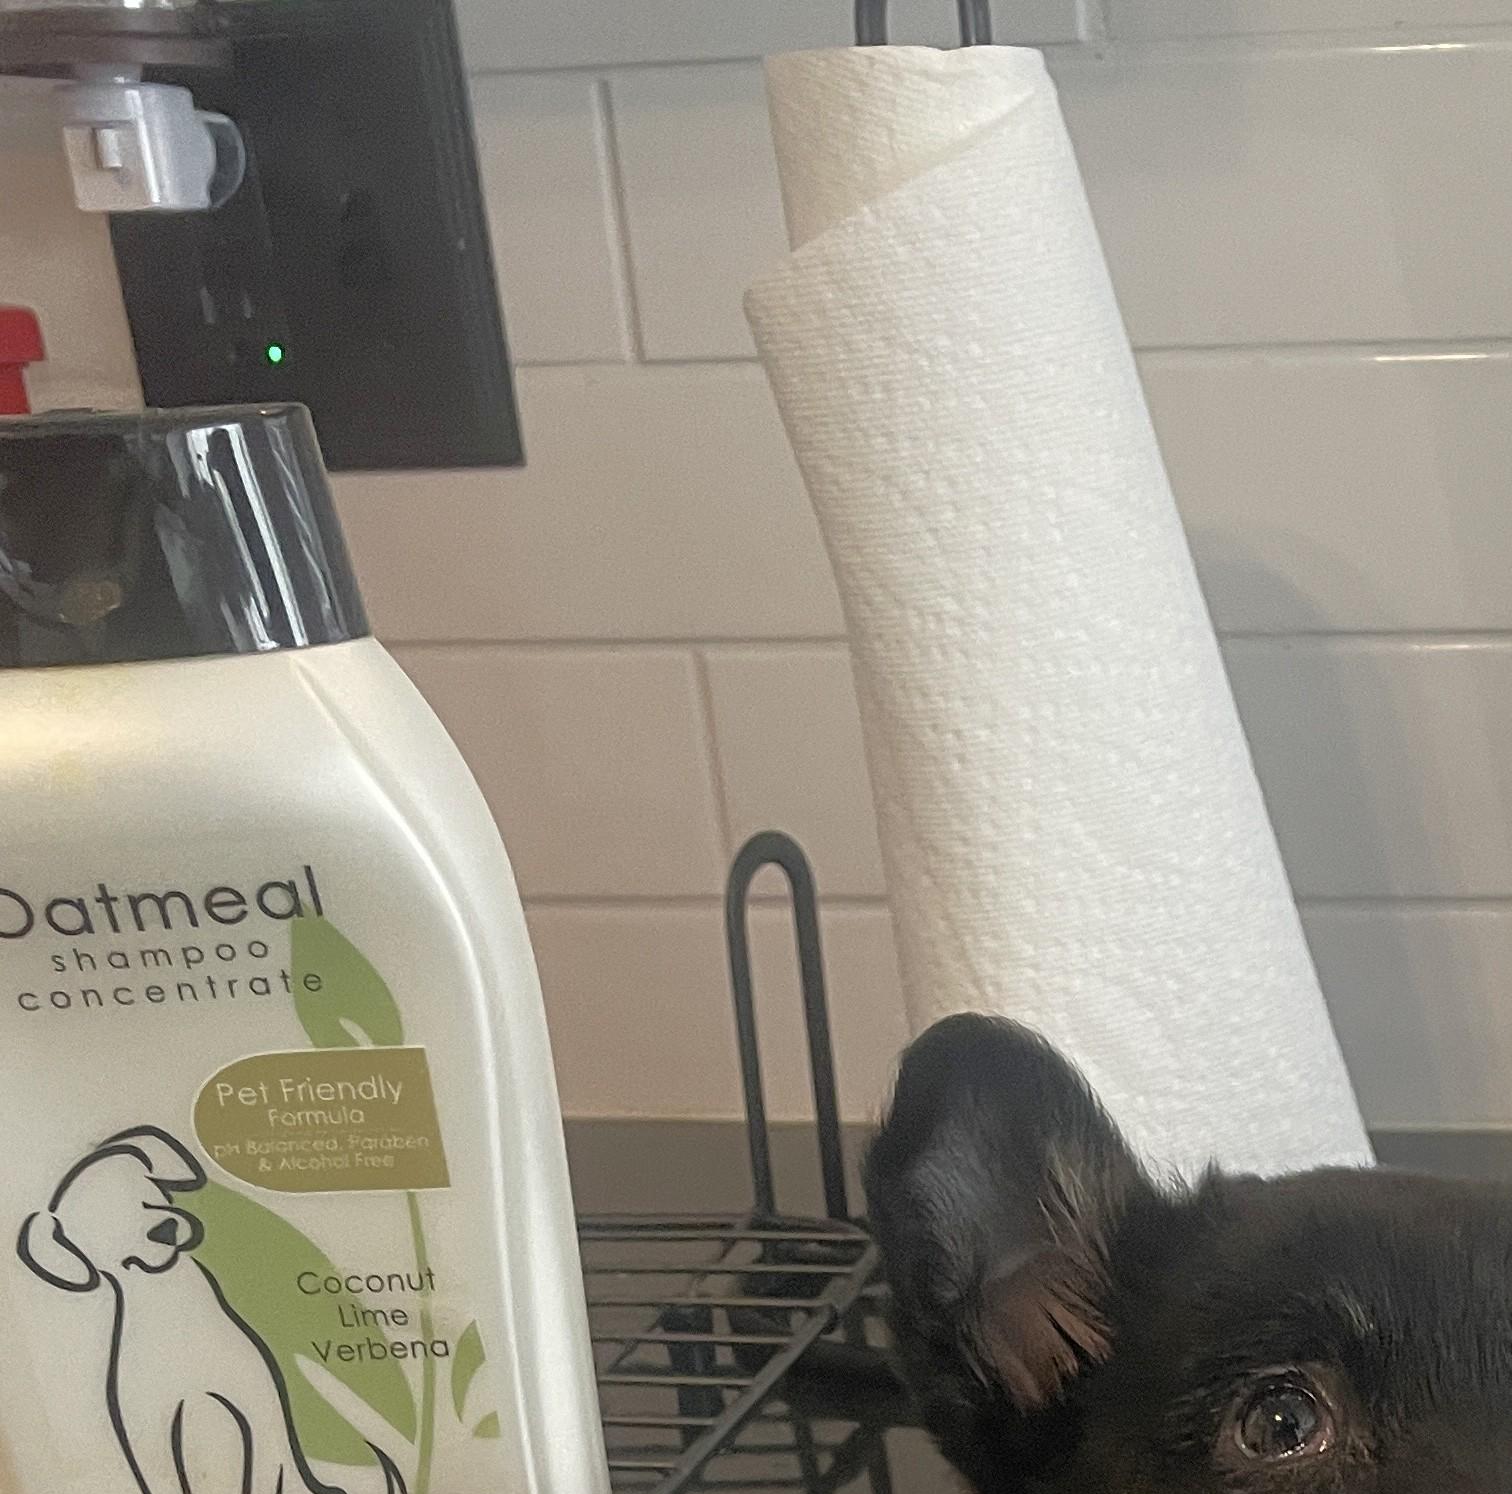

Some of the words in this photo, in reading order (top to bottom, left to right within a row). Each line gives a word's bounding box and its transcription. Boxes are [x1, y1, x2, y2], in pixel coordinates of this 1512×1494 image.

[51, 940, 268, 972] shampoo
[17, 969, 322, 1011] concentrate
[216, 1082, 268, 1106] Pet
[280, 1074, 402, 1104] Friendly
[268, 1106, 365, 1127] Formula
[279, 1153, 349, 1171] Alcohol
[355, 1152, 395, 1169] Free
[297, 1266, 436, 1295] Coconut
[338, 1304, 409, 1328] Lime
[311, 1337, 450, 1362] Verbena
